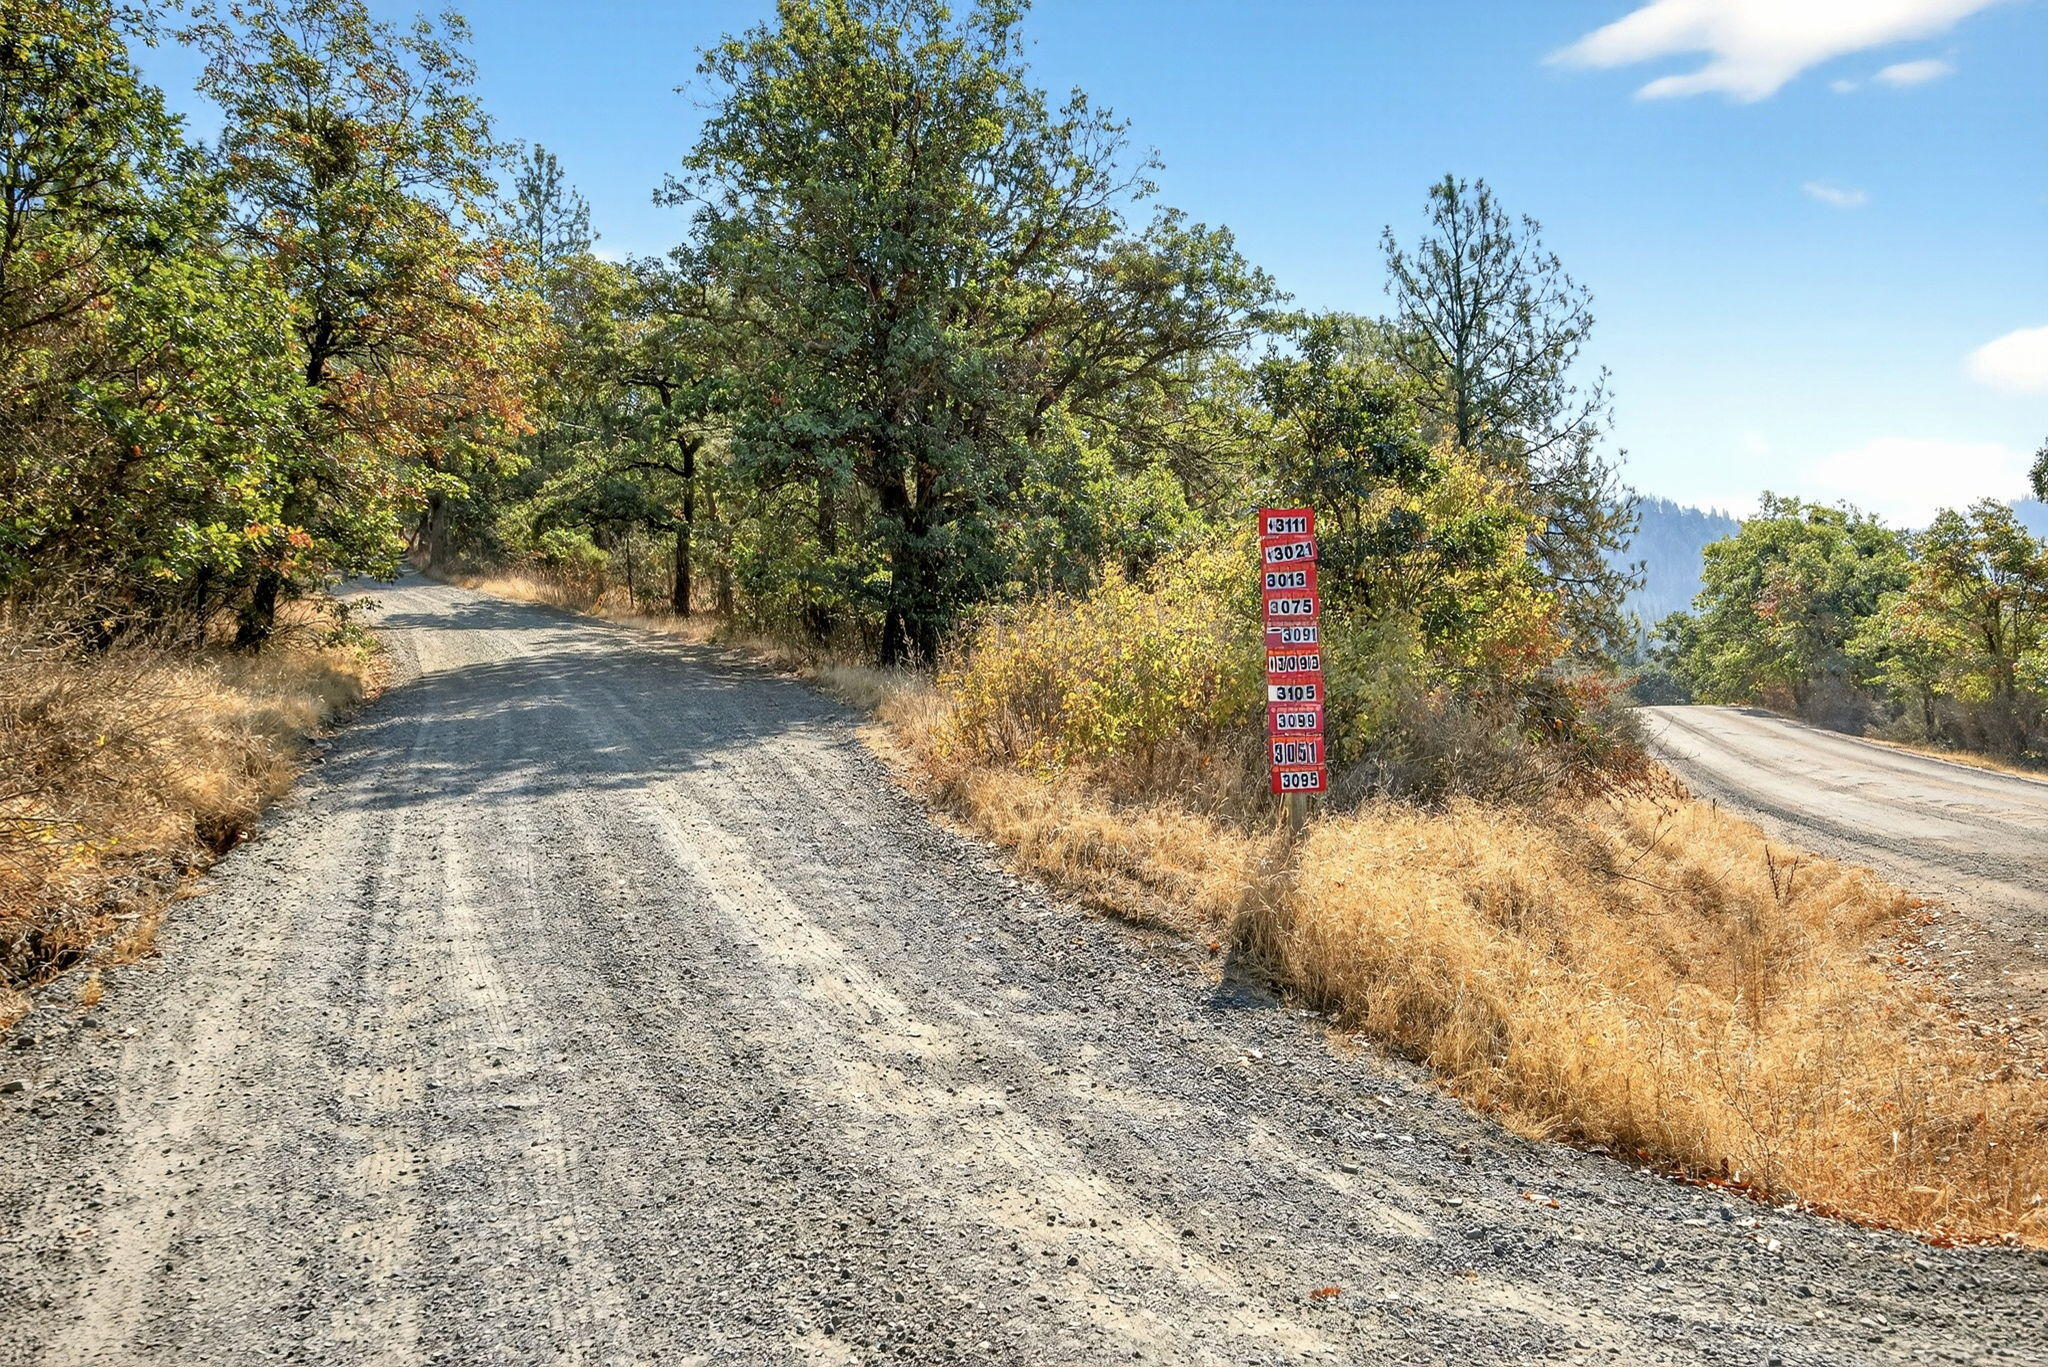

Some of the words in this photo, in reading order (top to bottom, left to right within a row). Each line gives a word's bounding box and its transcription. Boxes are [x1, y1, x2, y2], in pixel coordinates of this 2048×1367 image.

[1276, 518, 1305, 532] 3111
[1274, 542, 1312, 560] 3021
[1267, 572, 1304, 587] 3013
[1270, 599, 1312, 614] 3075
[1283, 628, 1316, 641] 3091
[1277, 685, 1315, 700] 3105
[1278, 714, 1315, 728] 3099
[1275, 742, 1316, 763] 3051
[1282, 772, 1318, 788] 3095
